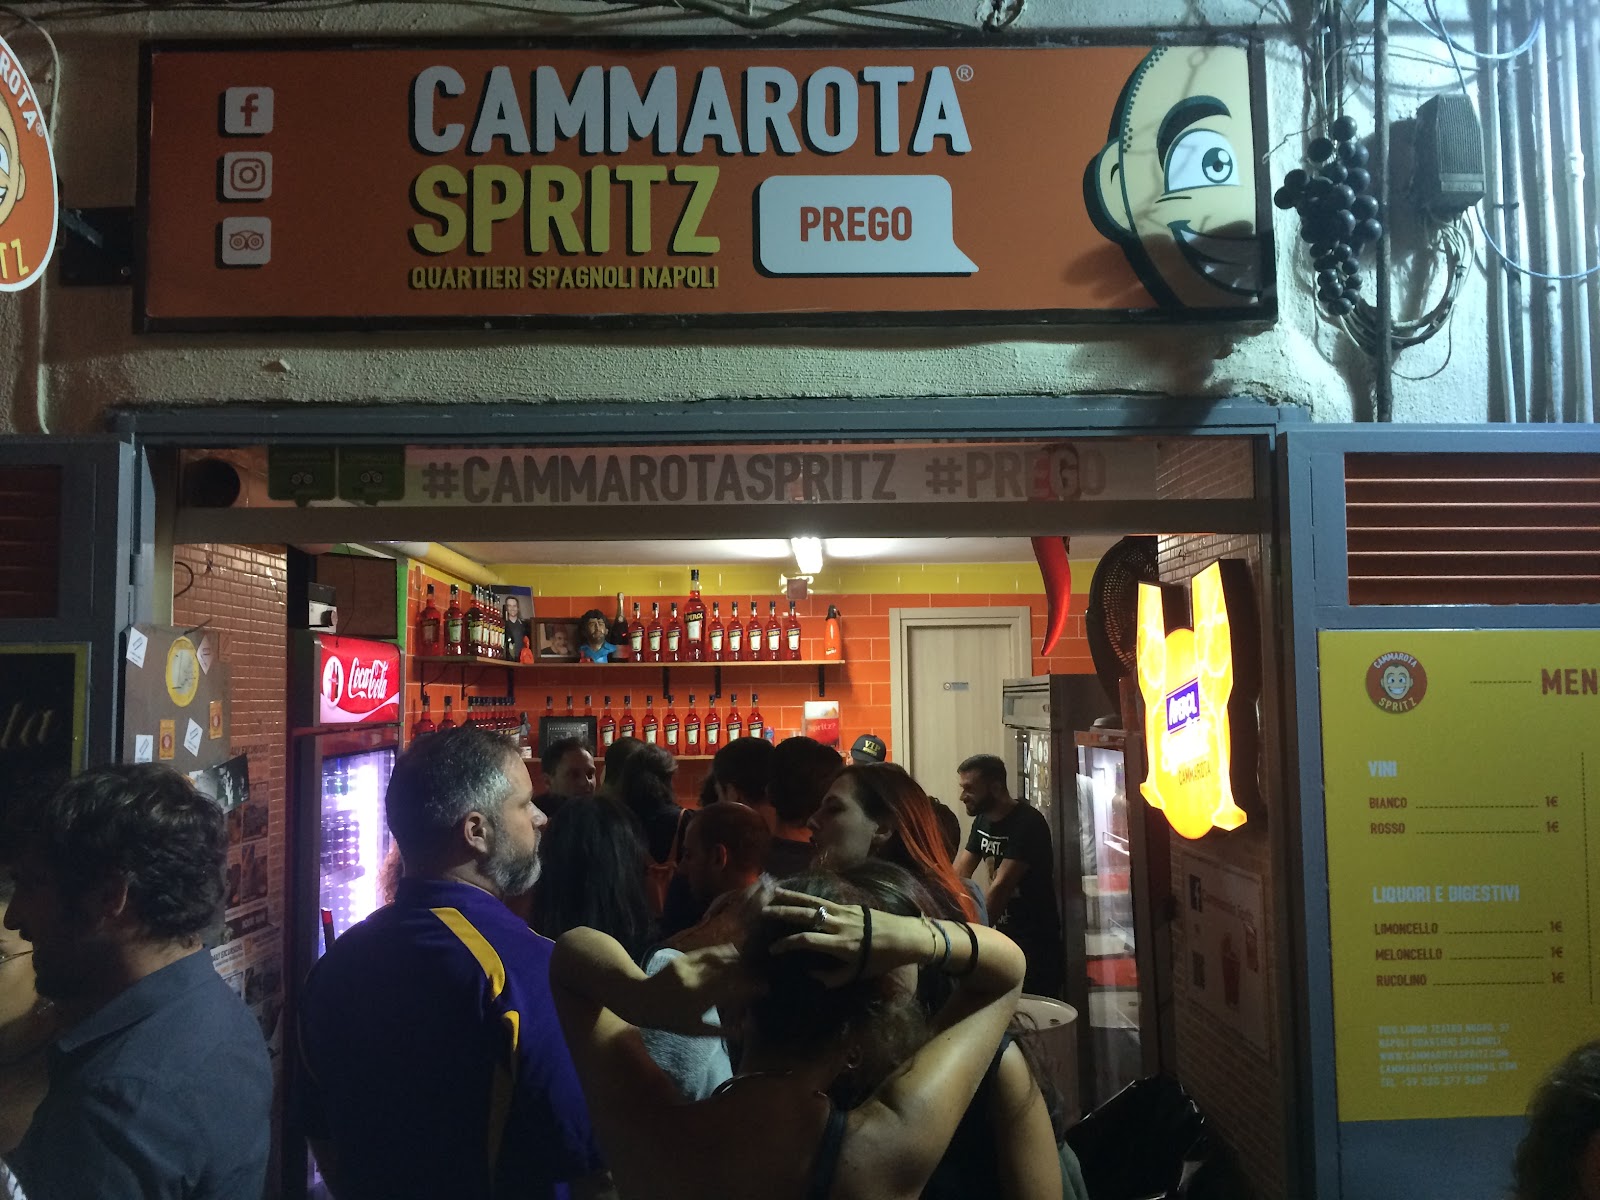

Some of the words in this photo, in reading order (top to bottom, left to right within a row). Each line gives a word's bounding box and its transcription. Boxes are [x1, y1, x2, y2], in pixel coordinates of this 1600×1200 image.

[410, 164, 720, 255] SPRITZ
[800, 205, 913, 242] PREGO
[411, 265, 525, 289] QUARTIERI
[531, 265, 636, 289] SPAGNOLI
[643, 265, 719, 288] NAPOLI
[422, 452, 897, 504] #CAMMAROTASPRITZ
[925, 451, 1107, 500] #PREGO
[1373, 652, 1418, 669] CAMMAROTA
[1541, 668, 1598, 696] MEN
[1378, 696, 1417, 712] SPRITZ
[865, 740, 881, 752] VIP
[1368, 760, 1398, 777] VINI
[1369, 797, 1407, 809] BIANCO
[1545, 796, 1559, 807] 1€
[1370, 822, 1406, 834] ROSSO
[1546, 821, 1560, 833] 1€
[1373, 885, 1431, 903] LIQUORI
[1435, 885, 1445, 902] E
[1449, 884, 1520, 902] DIGESTIVI
[1374, 922, 1439, 936] LIMONCELLO
[1375, 948, 1442, 961] MELONCELLO
[1376, 974, 1427, 987] RUCOLINO
